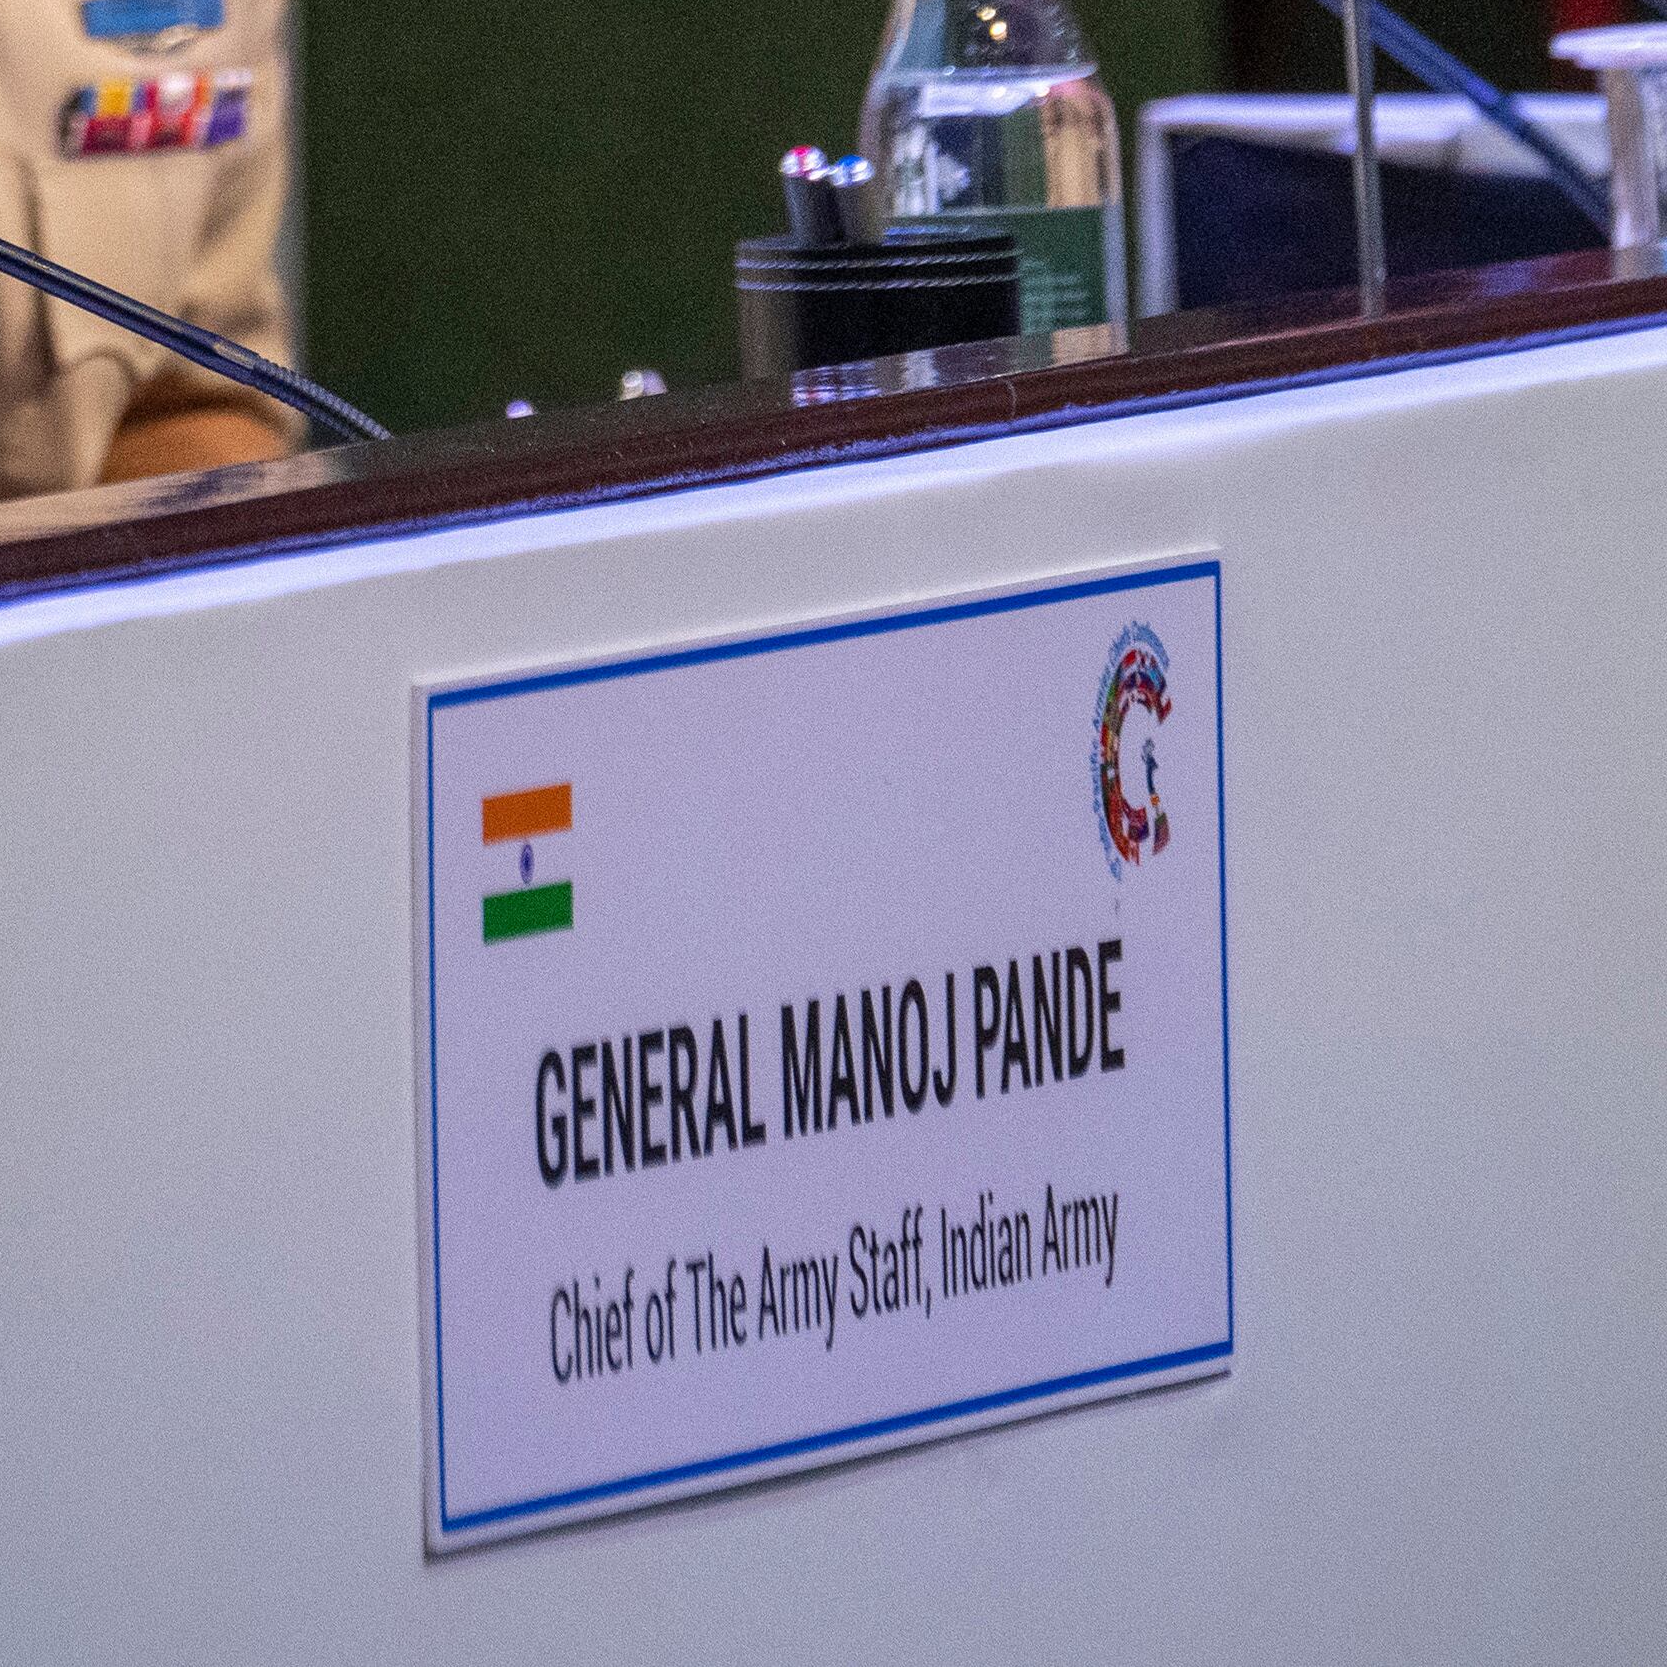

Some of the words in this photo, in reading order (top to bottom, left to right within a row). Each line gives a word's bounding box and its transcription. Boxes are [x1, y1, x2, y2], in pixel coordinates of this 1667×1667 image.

[536, 1012, 767, 1190] GENERAL
[780, 972, 957, 1140] MANOJ
[973, 939, 1125, 1100] PANDE
[550, 1264, 635, 1384] Chief
[646, 1257, 676, 1365] of
[686, 1250, 747, 1356] The
[759, 1241, 839, 1352] Army
[848, 1203, 931, 1320] Staff,
[941, 1190, 1033, 1300] Indian
[1043, 1183, 1119, 1289] Army
